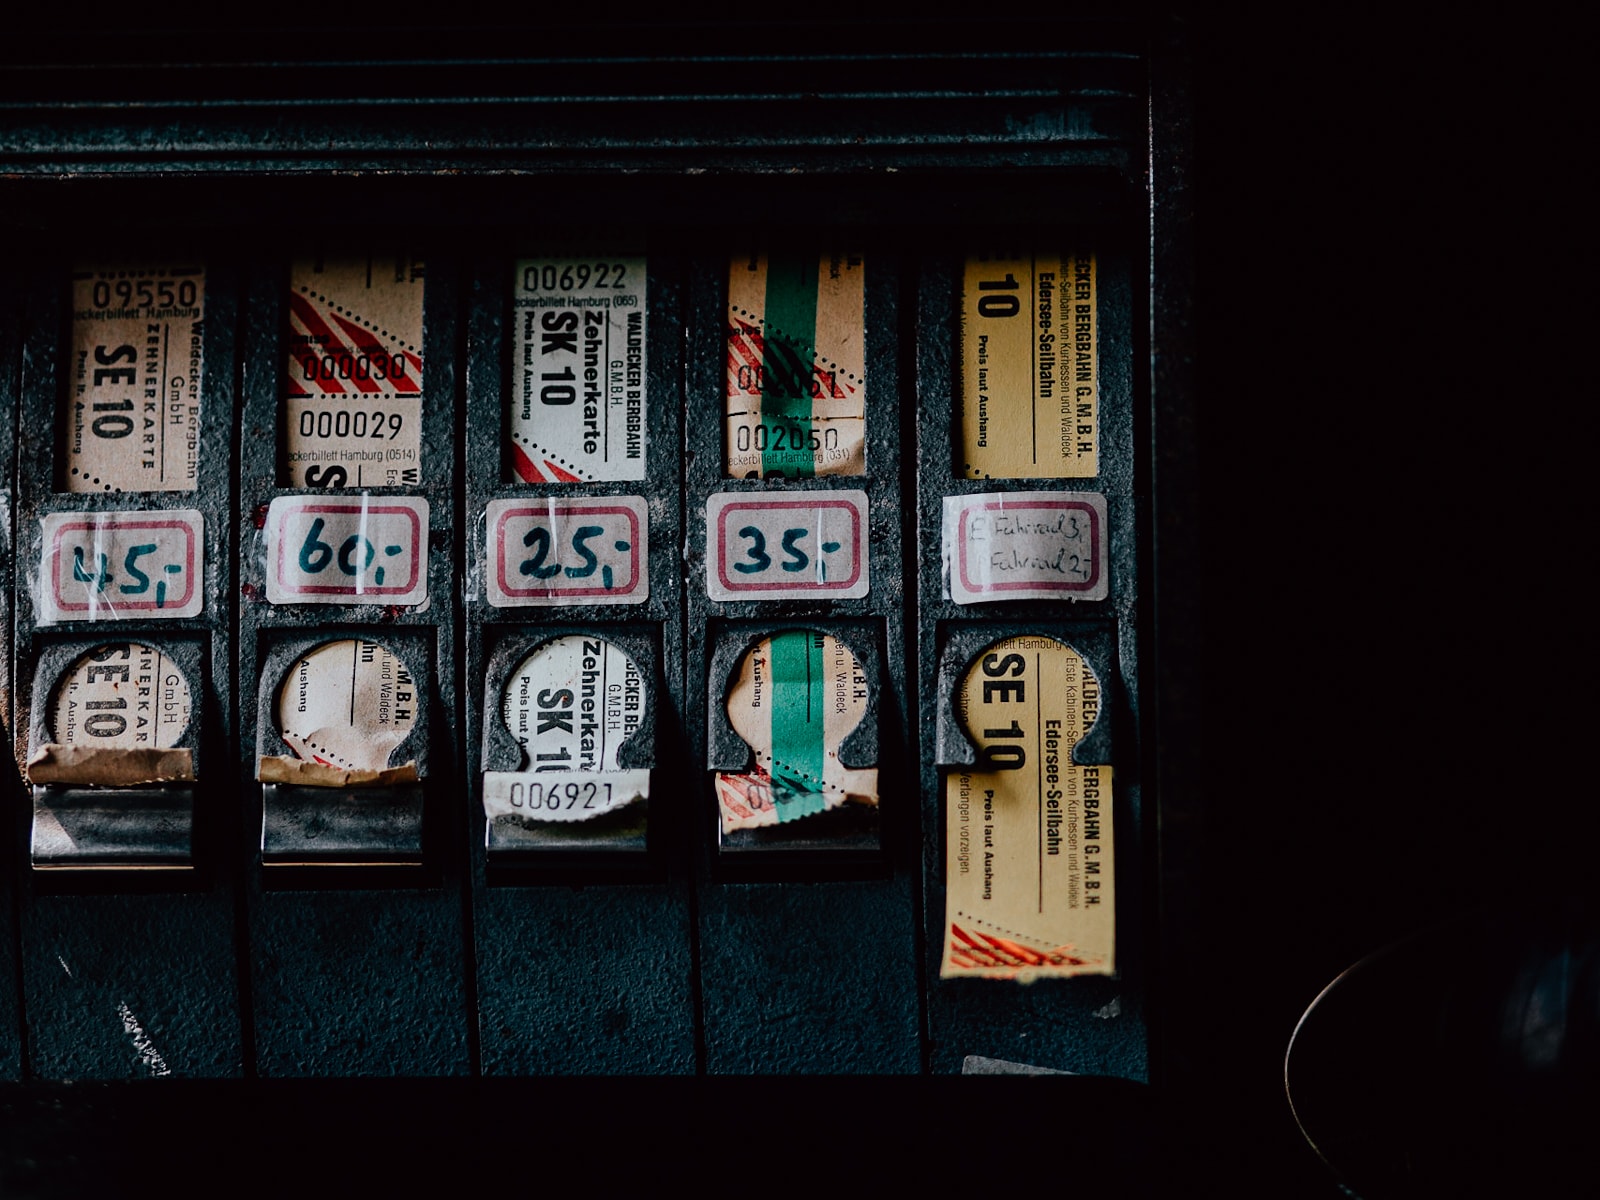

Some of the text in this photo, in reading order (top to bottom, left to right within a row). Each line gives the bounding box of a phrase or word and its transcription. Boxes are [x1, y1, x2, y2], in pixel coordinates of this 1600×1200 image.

[92, 279, 198, 309] 09550
[523, 263, 627, 291] 006922
[567, 295, 611, 308] Hamburg
[977, 273, 1020, 318] 10
[1038, 272, 1055, 399] Edersee-Seilbahn
[1060, 324, 1070, 341] von
[1074, 303, 1092, 382] BERGBAHN
[78, 350, 88, 382] Preis
[188, 320, 204, 400] Waldecker
[303, 353, 406, 382] 000030
[521, 311, 535, 421] Preis laut Aushang
[540, 311, 579, 406] SK 10
[583, 310, 604, 455] Zehnerkarte
[1059, 343, 1072, 393] Kurhessen
[92, 345, 138, 440] SE 10
[143, 323, 160, 470] ZEHNERKARTE
[170, 376, 185, 426] GmbH
[610, 359, 625, 409] G.M.B.H.
[625, 311, 643, 460] WALDECKER BERGBAHN
[976, 335, 989, 448] Preis laut Aushang
[1060, 395, 1072, 414] und
[299, 409, 404, 441] 000029
[737, 425, 839, 452] 002050
[1060, 416, 1073, 459] Waldeck
[340, 449, 384, 462] Hamburg
[385, 449, 417, 462] (0514)
[73, 543, 182, 608] 45,-
[298, 517, 403, 586] 60,-
[518, 525, 631, 590] 25,-
[1018, 638, 1063, 651] Hamburg
[298, 660, 310, 713] Aushang
[519, 676, 531, 706] Preis
[752, 658, 765, 708] Aushang
[835, 672, 848, 714] Waldeck
[982, 653, 1026, 704] SE
[1066, 657, 1078, 683] Erste
[84, 696, 127, 738] 10
[163, 674, 180, 724] GmbH
[379, 683, 393, 725] Waldeck
[519, 708, 530, 733] laut
[537, 688, 575, 735] SK
[608, 684, 622, 734] G.M.B.H.
[983, 720, 1026, 771] 10
[509, 781, 613, 811] 006921
[1045, 719, 1063, 856] Edersee-Seilbahn
[1066, 776, 1076, 794] von
[982, 789, 995, 900] Preis laut Aushang
[1066, 797, 1078, 851] Kurhessen
[1066, 852, 1078, 870] und
[1066, 872, 1078, 909] Waldeck
